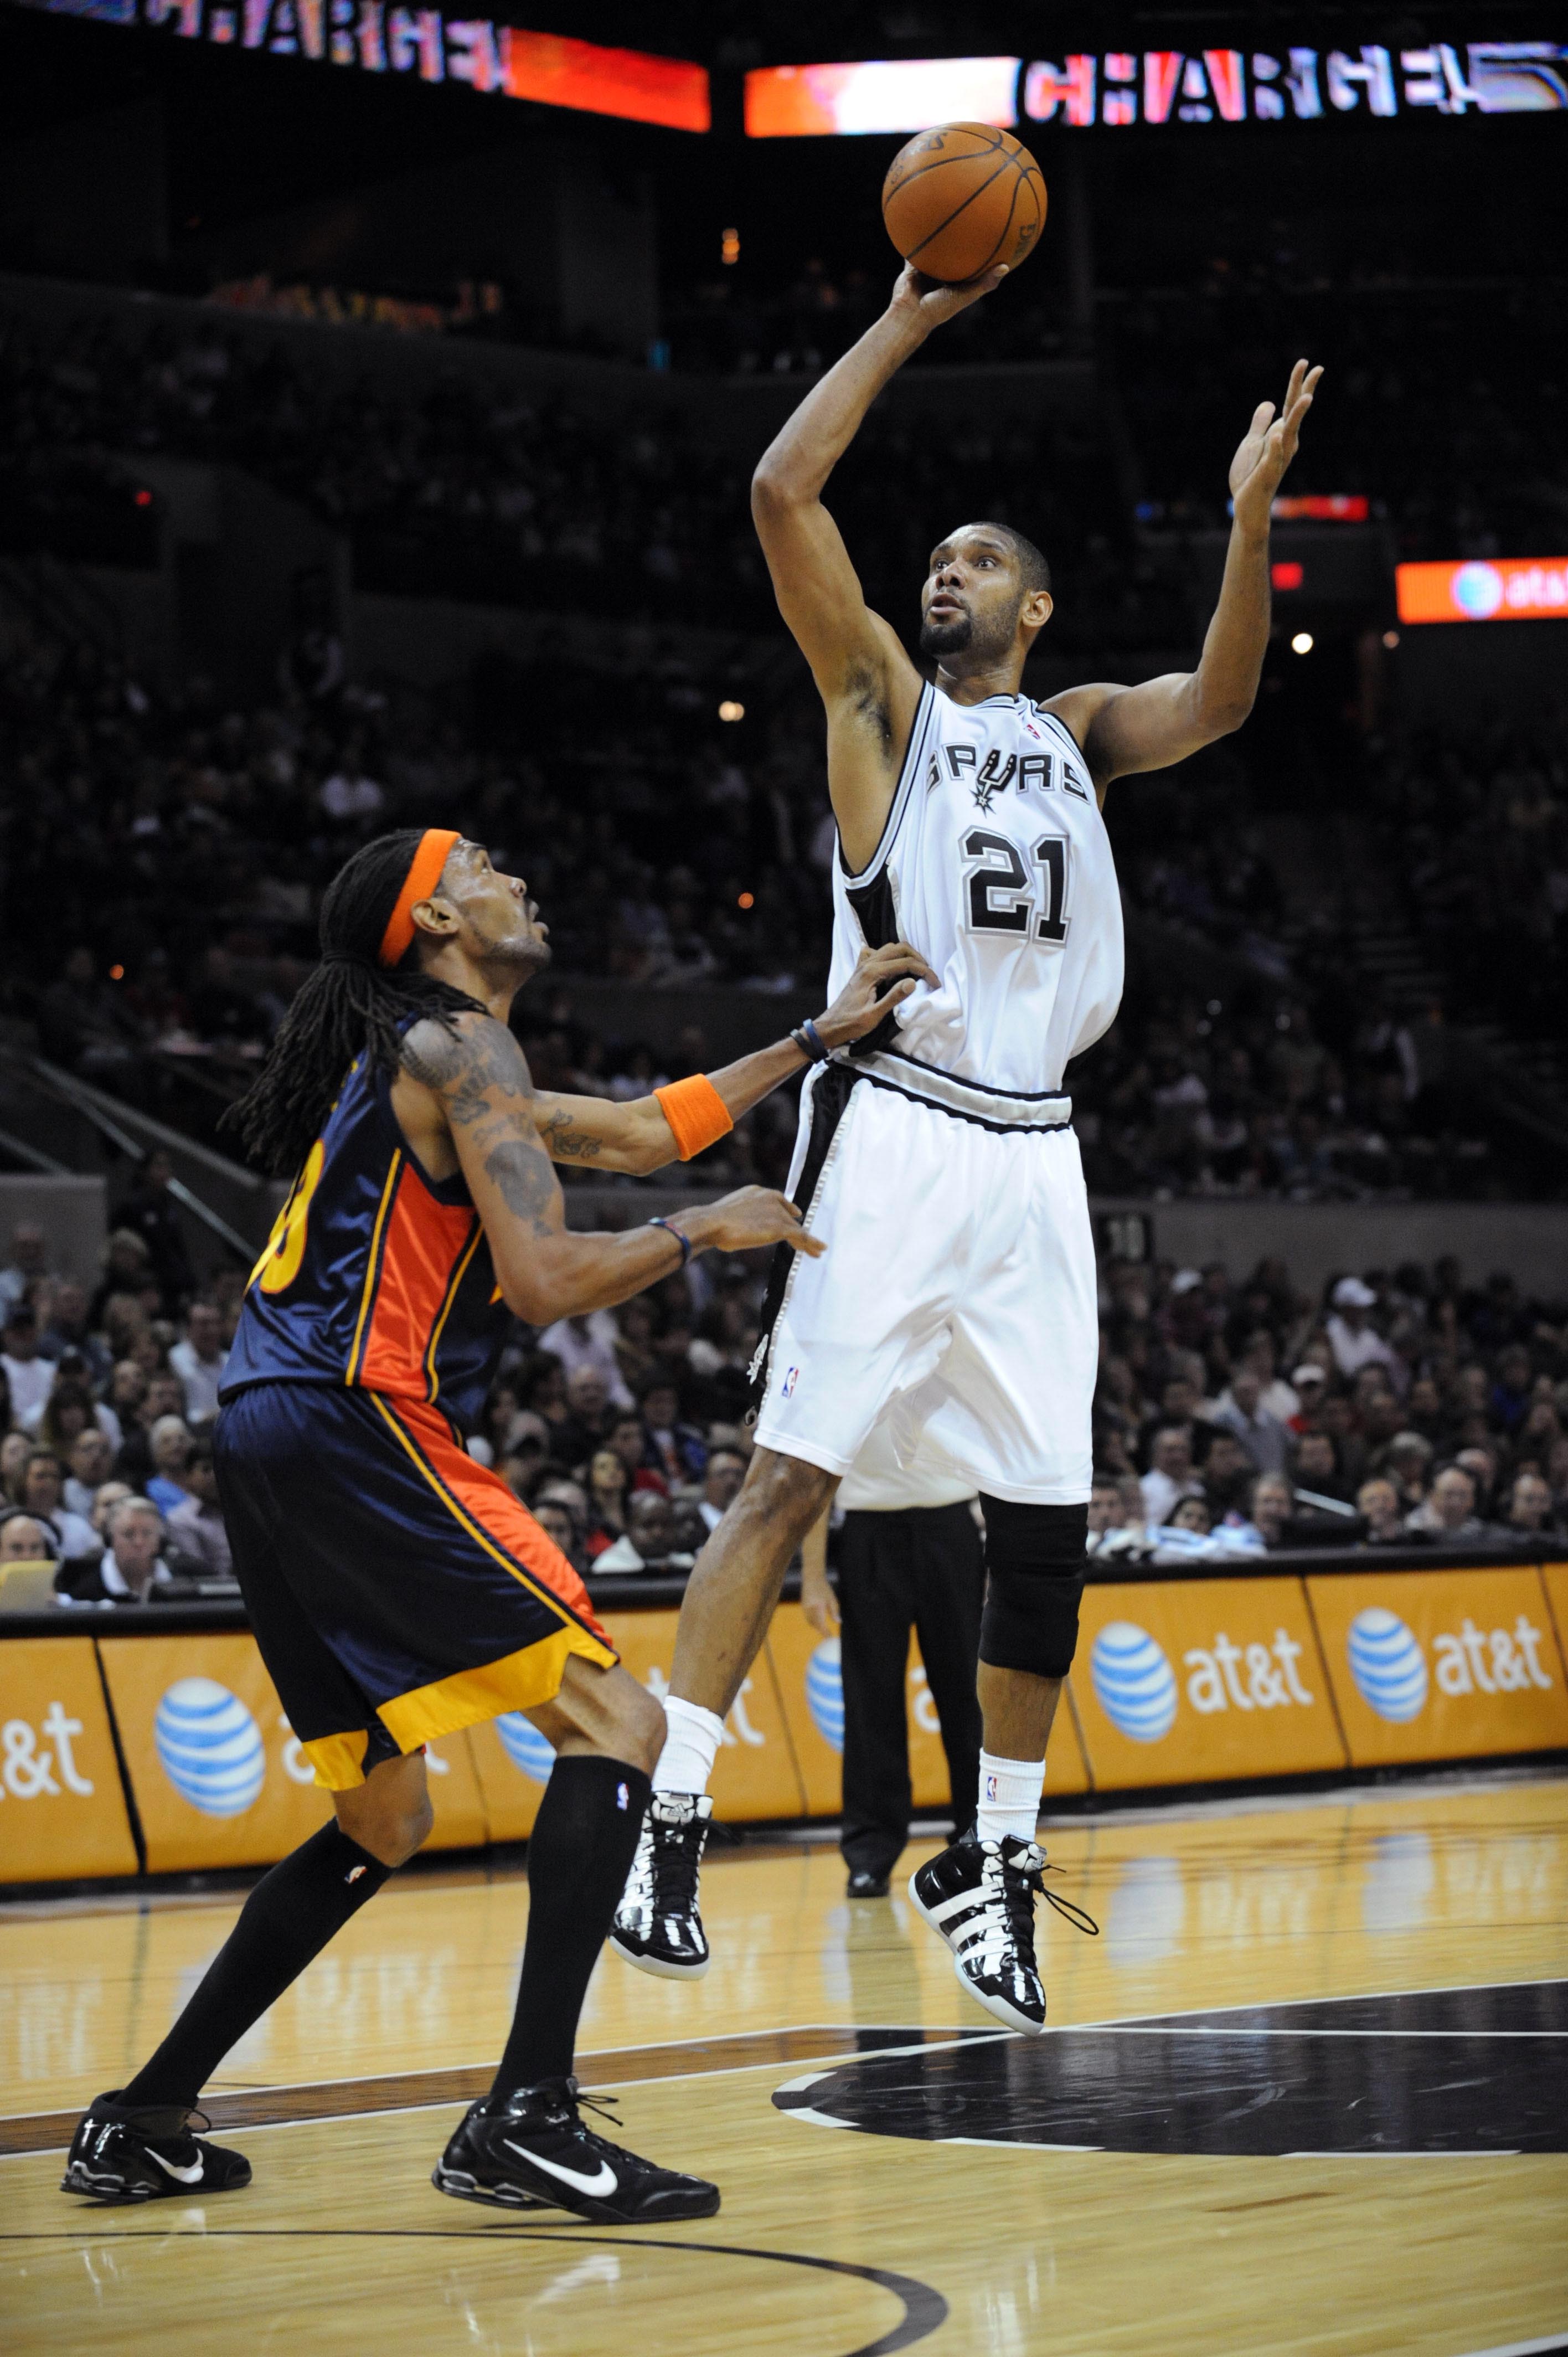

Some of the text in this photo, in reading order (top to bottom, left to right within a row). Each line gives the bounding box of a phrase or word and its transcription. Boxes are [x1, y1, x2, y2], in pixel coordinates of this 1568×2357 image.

[958, 825, 1072, 949] 21
[1183, 1627, 1314, 1715] at&t
[1432, 1614, 1551, 1697] at&t
[0, 1701, 95, 1799] &t
